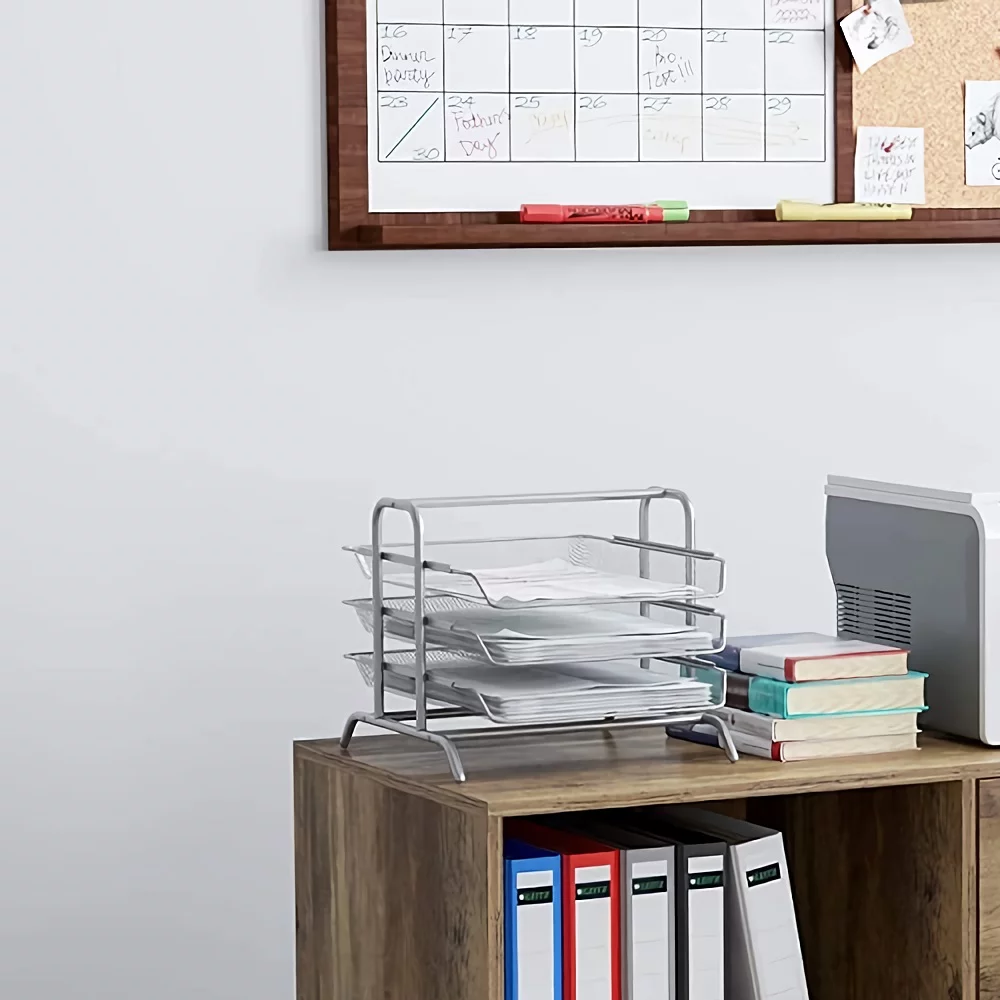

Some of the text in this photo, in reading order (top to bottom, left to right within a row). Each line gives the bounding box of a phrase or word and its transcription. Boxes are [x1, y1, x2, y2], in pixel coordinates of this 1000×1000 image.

[381, 25, 408, 39] 16
[447, 27, 474, 43] 17
[514, 27, 537, 40] 18
[579, 27, 603, 47] 19
[642, 28, 668, 42] 20
[706, 30, 728, 43] 21
[768, 31, 796, 44] 22
[380, 95, 408, 108] 23
[447, 95, 477, 108] 24
[515, 95, 543, 109] 25
[580, 95, 607, 109] 26
[643, 96, 672, 112] 27
[706, 96, 732, 111] 28
[768, 97, 792, 116] 29
[459, 132, 501, 159] Day
[412, 147, 440, 161] 30
